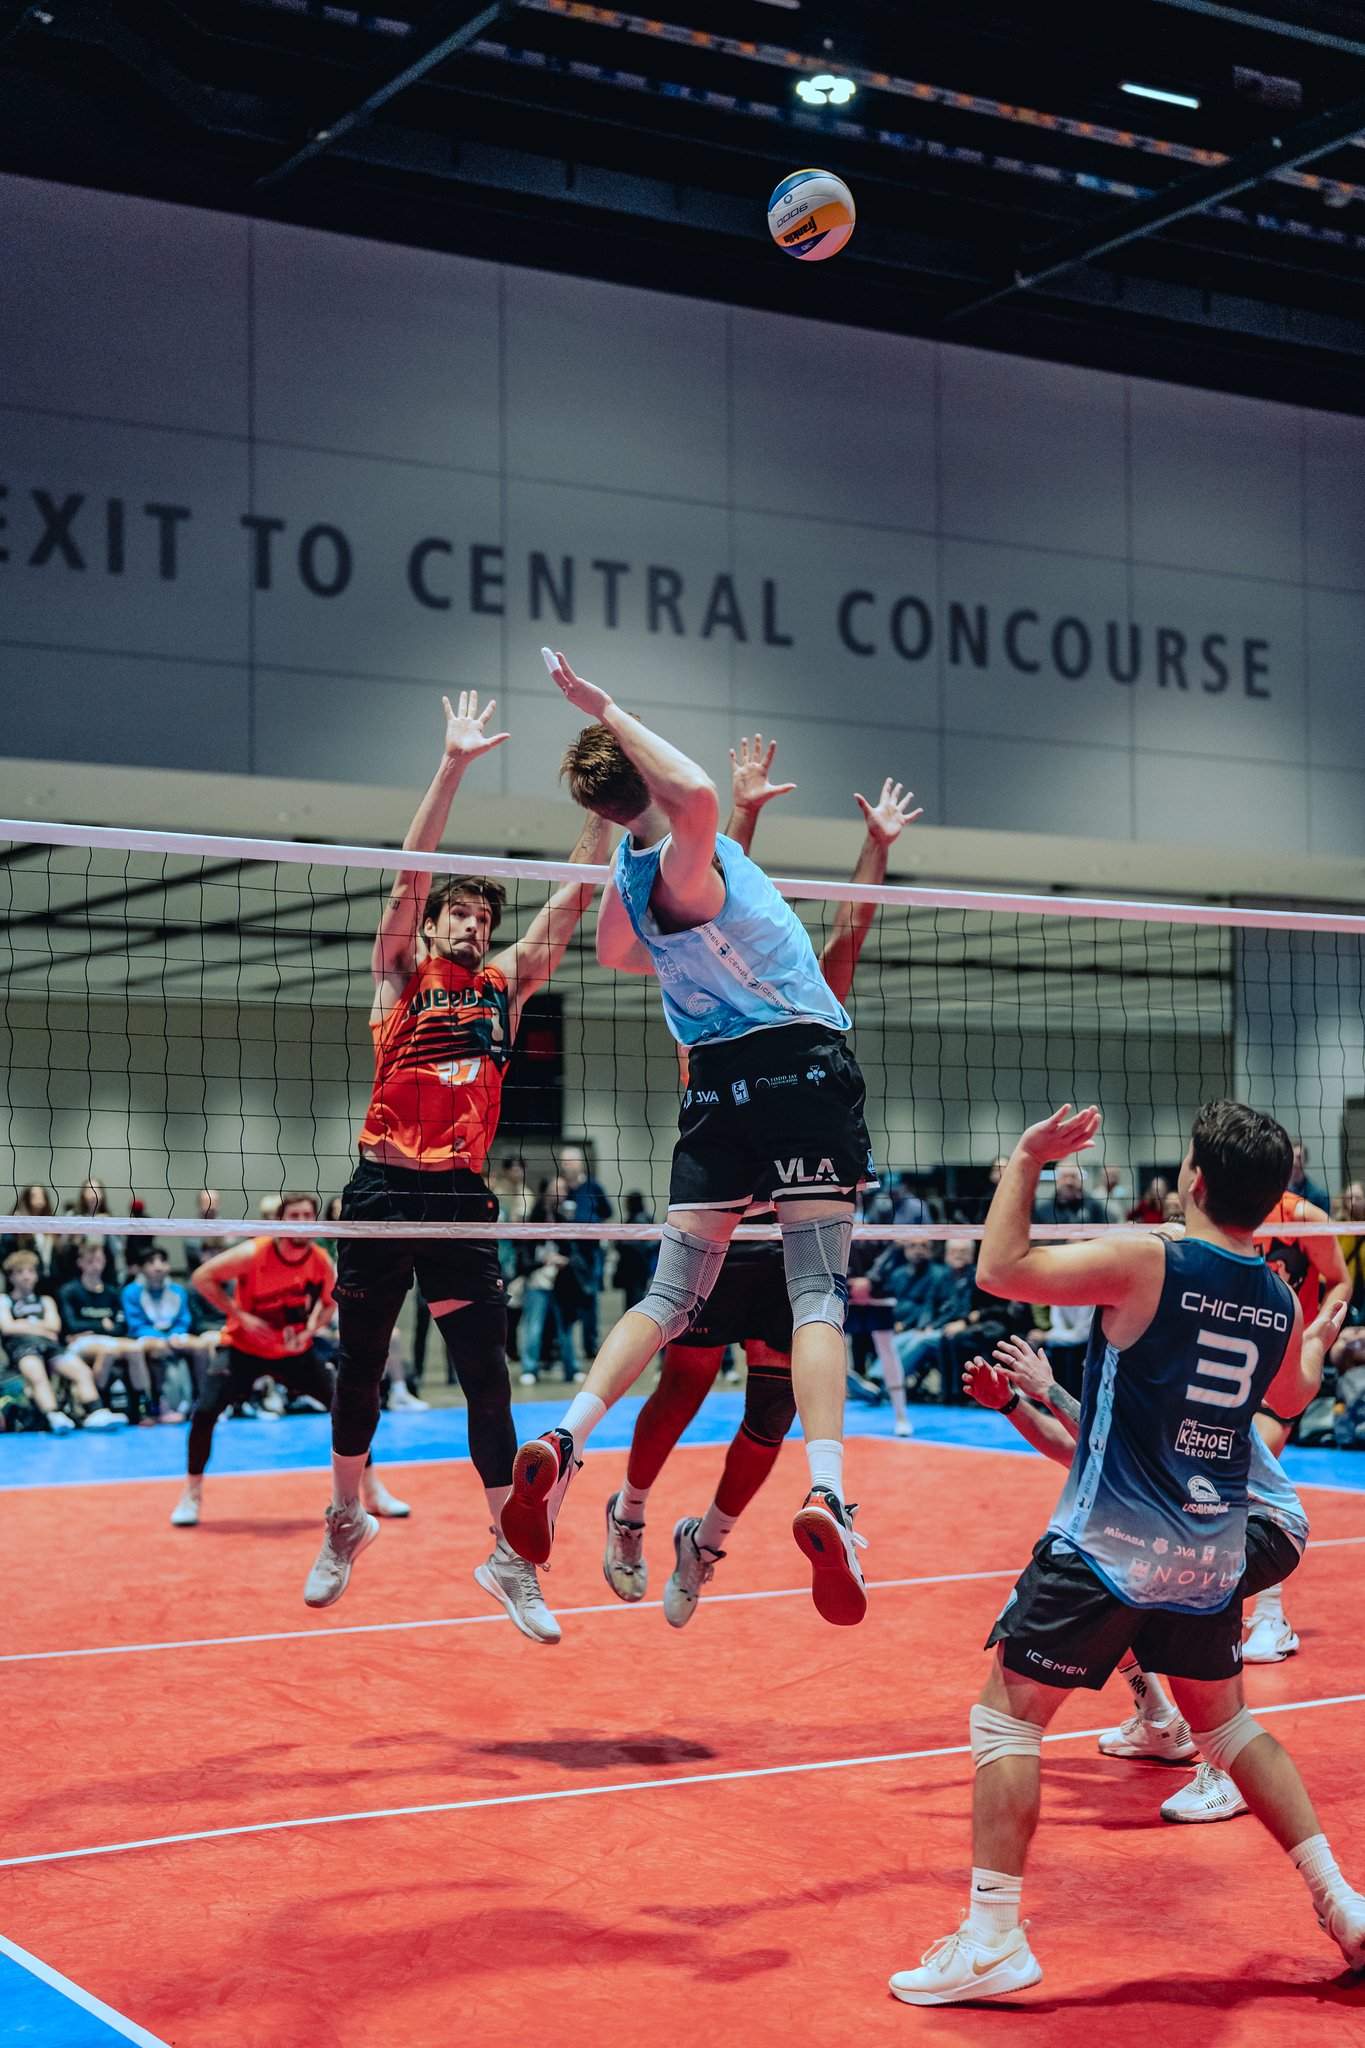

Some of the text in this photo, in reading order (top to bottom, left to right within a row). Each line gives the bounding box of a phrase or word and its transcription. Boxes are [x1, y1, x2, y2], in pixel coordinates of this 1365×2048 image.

[776, 202, 808, 228] 9000
[0, 485, 1272, 700] XIT TO CENTRAL CONCOURSE
[727, 956, 749, 980] ICEMEN
[437, 1058, 482, 1086] 27
[695, 1091, 720, 1103] JVA
[773, 1158, 840, 1184] VLA
[1181, 1291, 1288, 1332] CHICAGO
[1185, 1328, 1260, 1409] 3
[1184, 1418, 1199, 1429] THE
[1179, 1428, 1230, 1451] KEHOE
[1184, 1447, 1218, 1460] GROUP
[1173, 1545, 1196, 1559] JVA
[1026, 1648, 1088, 1676] ICEMEN
